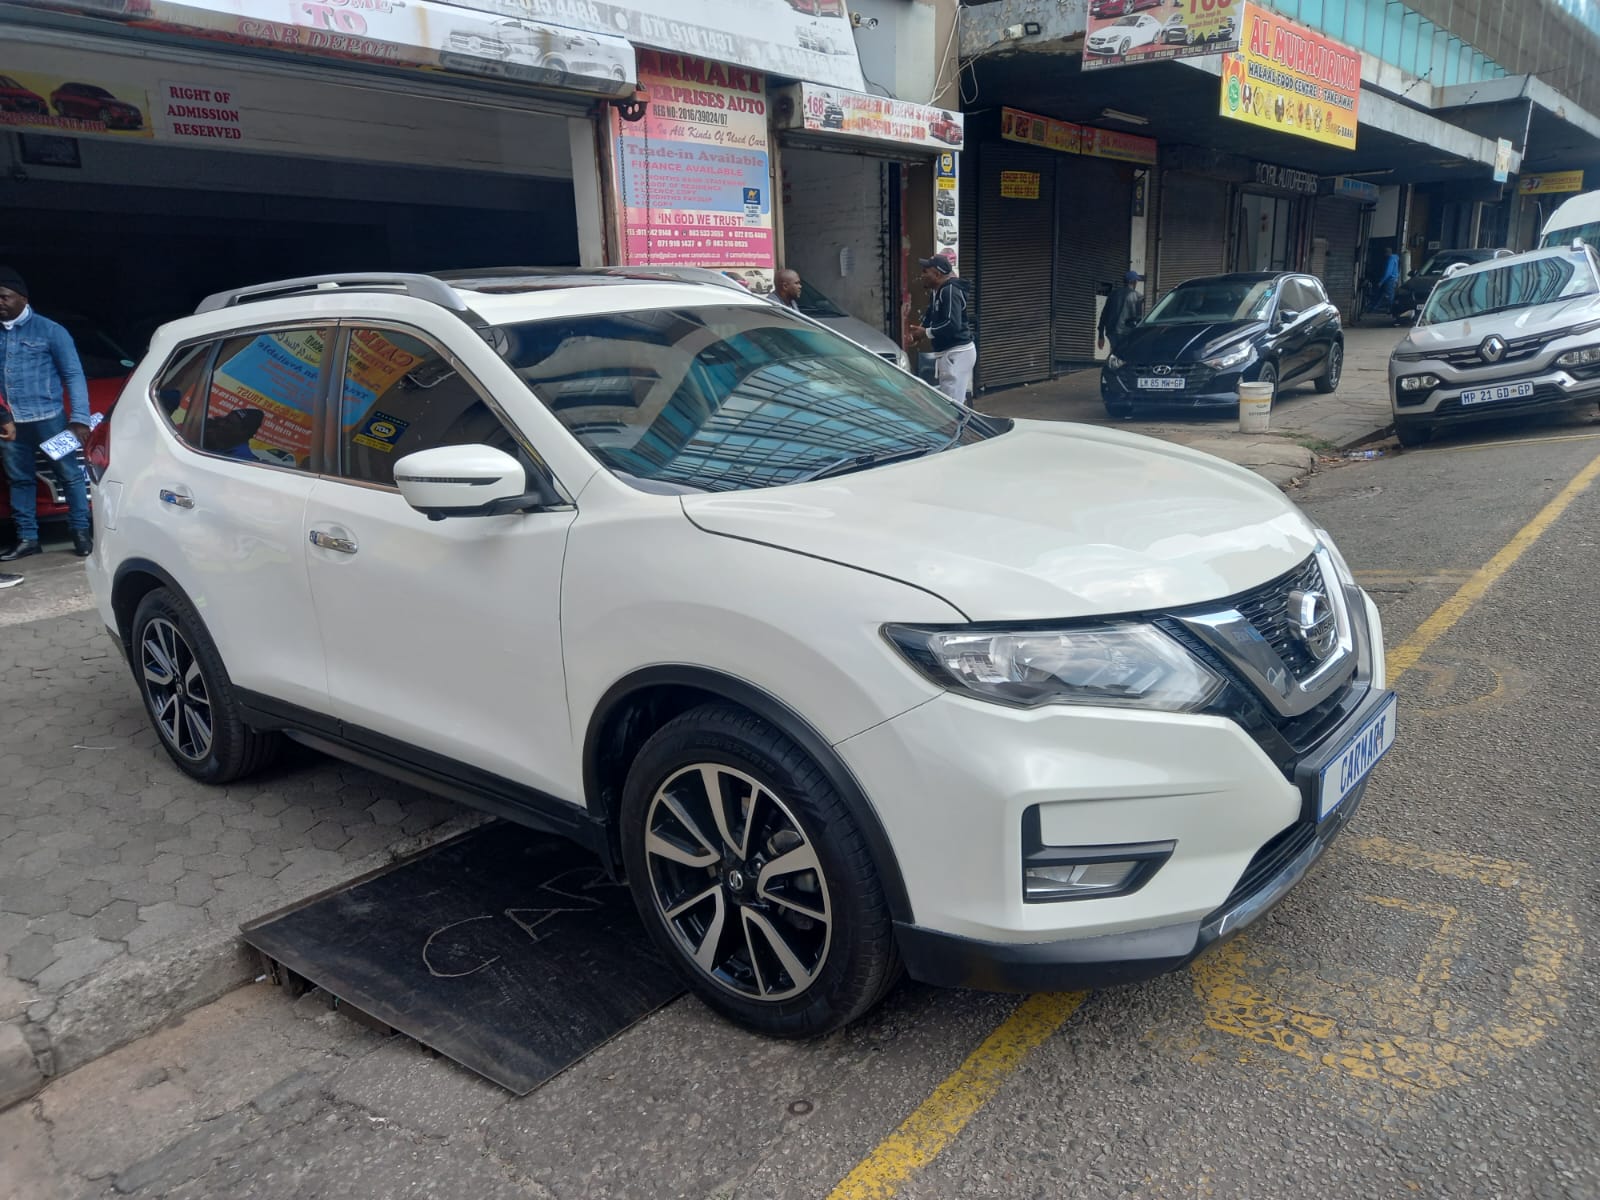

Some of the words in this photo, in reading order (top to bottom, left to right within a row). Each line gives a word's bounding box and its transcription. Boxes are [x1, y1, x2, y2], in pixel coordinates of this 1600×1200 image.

[302, 2, 368, 36] TO
[238, 20, 301, 45] CAR
[308, 31, 400, 58] DEPOT
[638, 47, 763, 94] ARMART
[169, 85, 211, 102] RIGHT
[214, 91, 231, 104] OF
[652, 84, 725, 110] ERPRISES
[727, 94, 766, 115] AUTO
[167, 103, 239, 122] ADMISSION
[652, 103, 666, 118] REG
[173, 122, 241, 140] RESERVED
[669, 125, 684, 138] All
[687, 126, 712, 140] Kinds
[714, 130, 725, 145] Of
[726, 131, 746, 144] Used
[748, 134, 766, 148] Cars
[626, 143, 694, 161] Trade-in
[698, 150, 765, 168] Available
[631, 160, 682, 172] FINANCE
[686, 164, 744, 177] AVAILABLE
[674, 213, 693, 225] GOD
[696, 214, 711, 225] WE
[1480, 390, 1493, 401] 21
[1517, 384, 1530, 396] GP
[1340, 714, 1387, 794] CARMART
